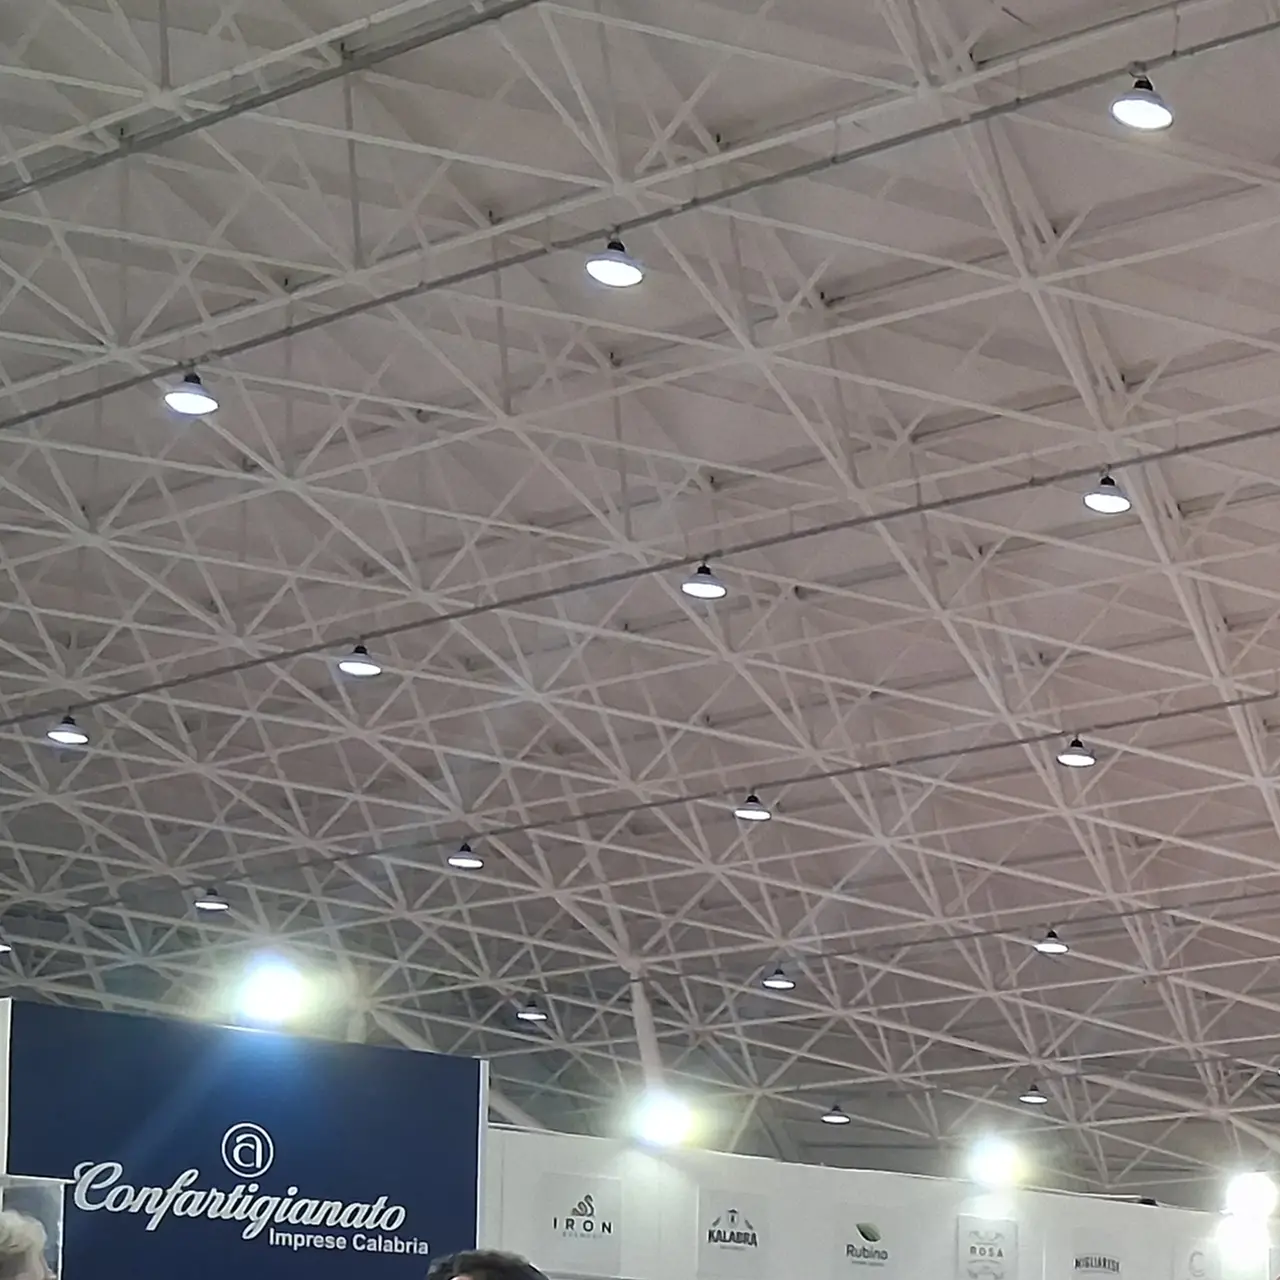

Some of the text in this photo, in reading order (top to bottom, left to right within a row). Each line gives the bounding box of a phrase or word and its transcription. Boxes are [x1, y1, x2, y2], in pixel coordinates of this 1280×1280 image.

[73, 1161, 407, 1240] Confartigianato
[553, 1217, 612, 1234] IRON
[269, 1228, 429, 1255] Imprese Calabria
[846, 1244, 889, 1261] Rubino
